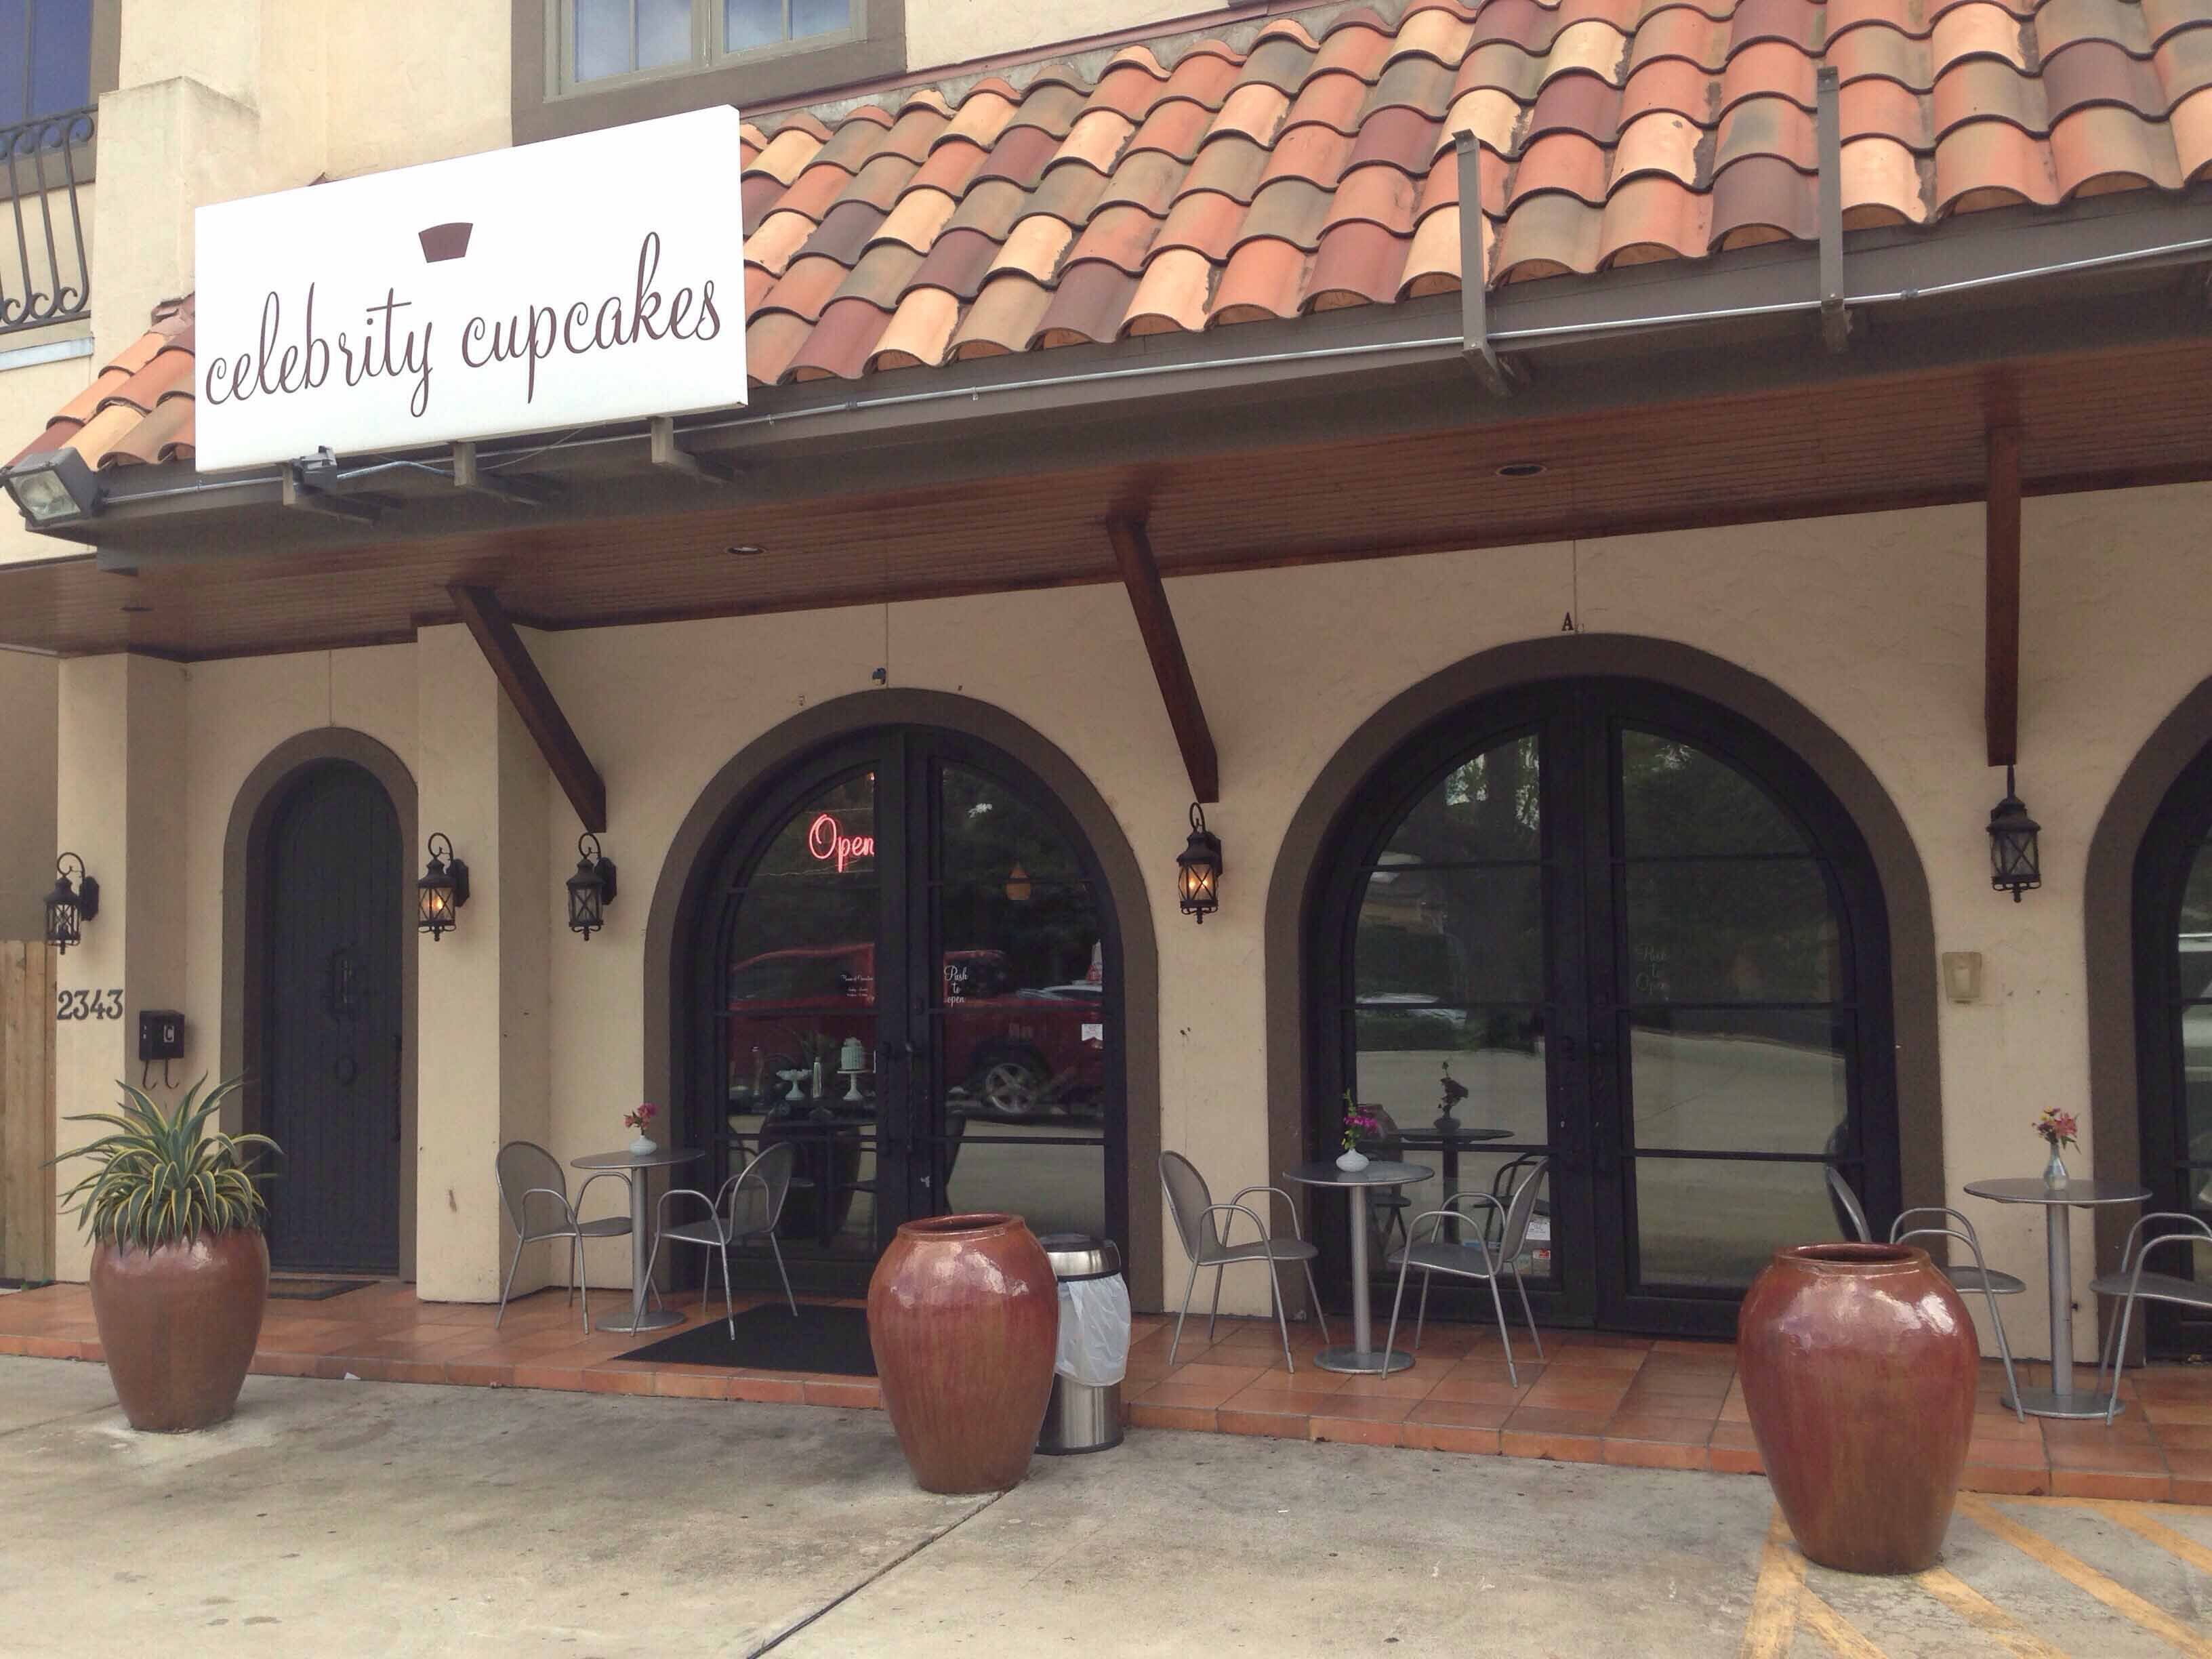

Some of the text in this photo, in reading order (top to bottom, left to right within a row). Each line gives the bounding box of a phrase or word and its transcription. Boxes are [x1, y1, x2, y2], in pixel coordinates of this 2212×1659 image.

[205, 231, 721, 418] celebrity cupcakes
[1561, 612, 1574, 632] A
[809, 813, 874, 873] Open
[943, 965, 968, 981] Push
[951, 982, 960, 994] to
[56, 989, 123, 1021] 2343
[947, 996, 965, 1008] open
